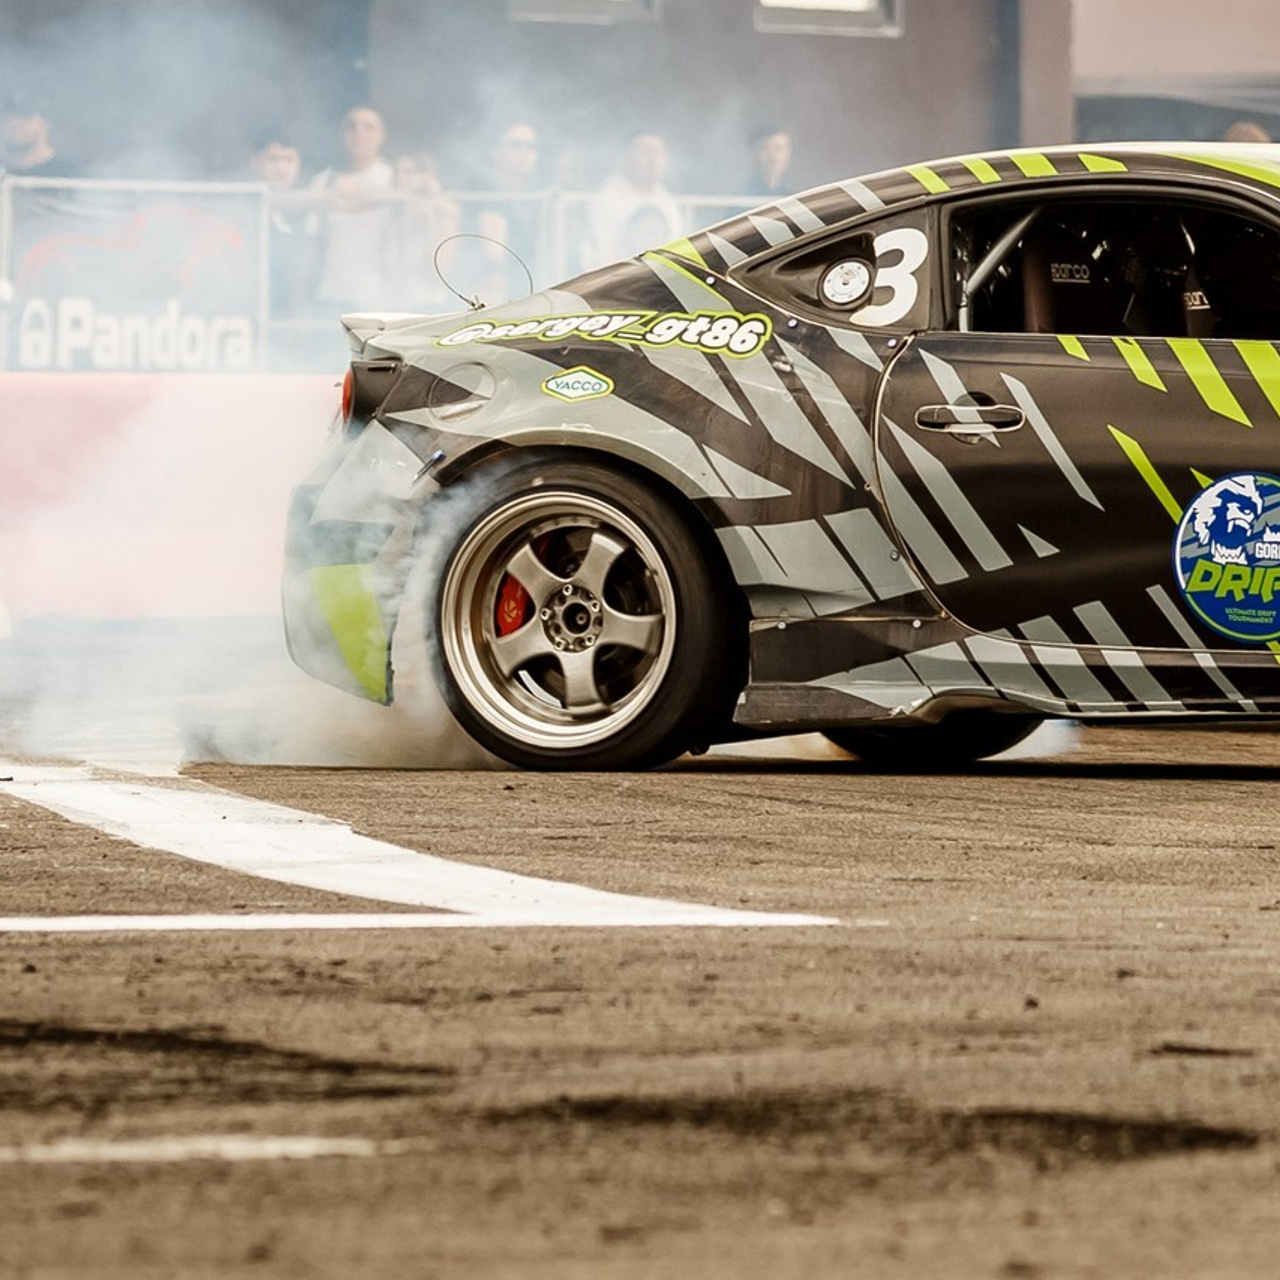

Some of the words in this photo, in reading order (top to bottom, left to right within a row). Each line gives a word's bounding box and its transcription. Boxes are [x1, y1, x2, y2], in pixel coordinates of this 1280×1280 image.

[57, 297, 252, 370] Pandora
[438, 312, 769, 355] @sergey_gt86
[554, 380, 602, 393] YACCO
